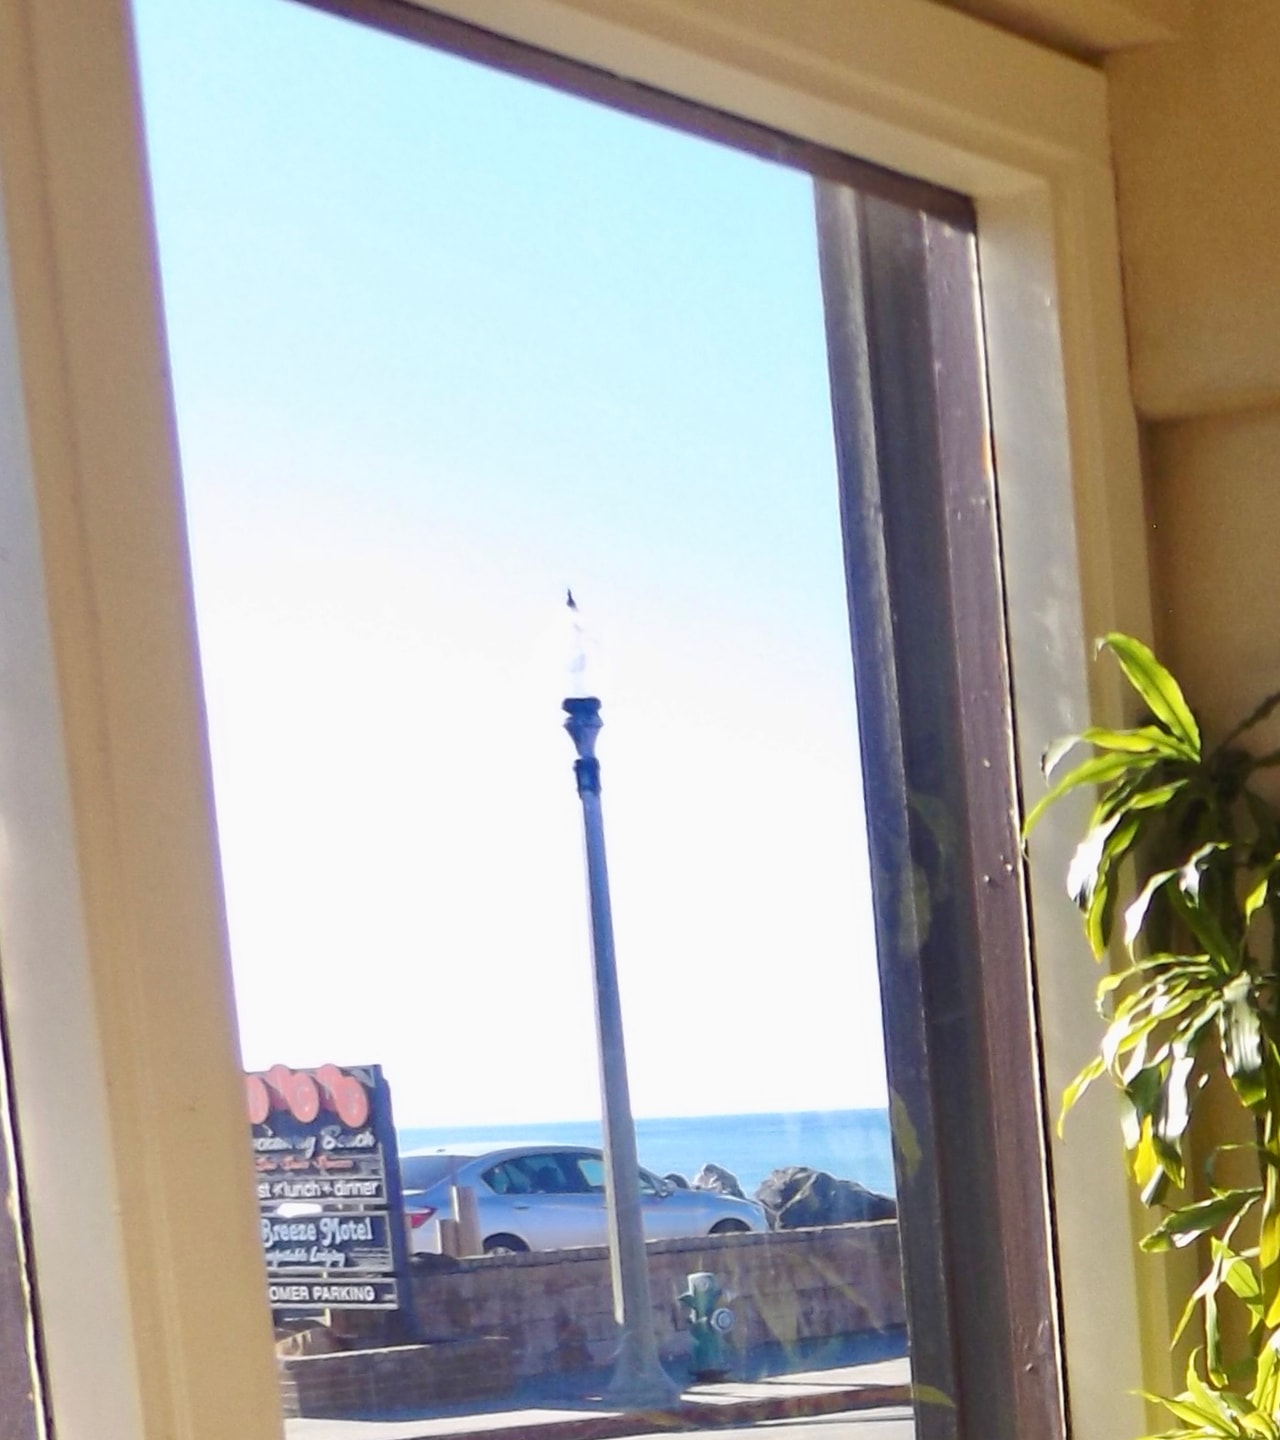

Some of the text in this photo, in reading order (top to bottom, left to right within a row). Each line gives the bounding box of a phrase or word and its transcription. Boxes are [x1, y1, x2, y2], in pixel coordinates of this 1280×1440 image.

[282, 1179, 321, 1197] lunch
[334, 1180, 378, 1197] dinner
[261, 1217, 373, 1246] Breeze Motel
[270, 1285, 375, 1301] OMER PARKING
